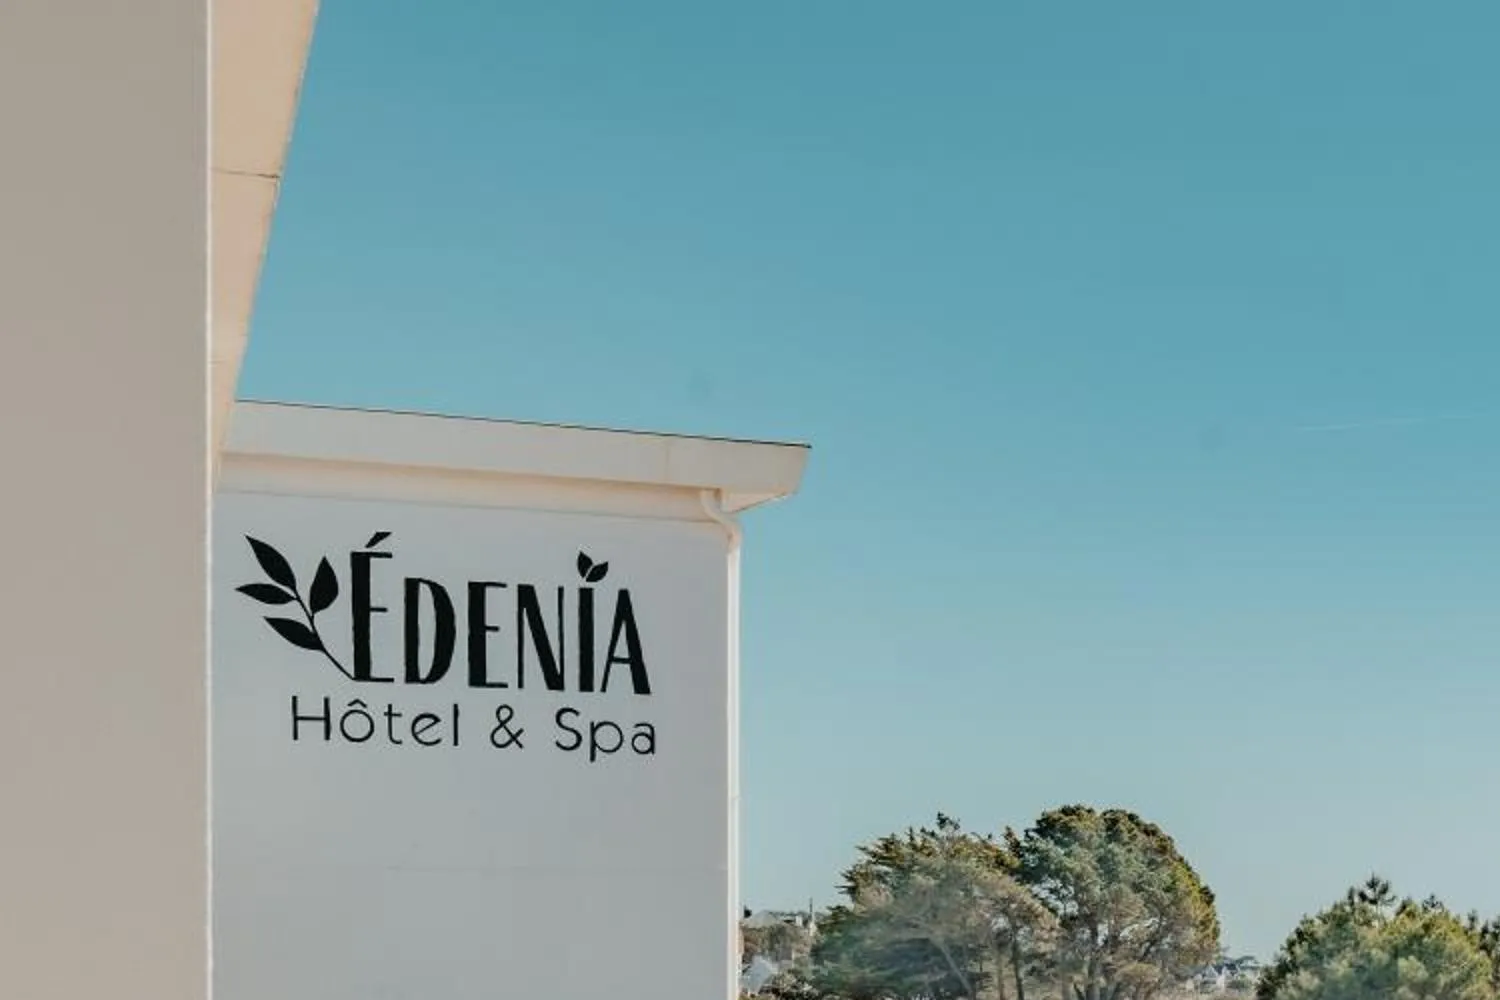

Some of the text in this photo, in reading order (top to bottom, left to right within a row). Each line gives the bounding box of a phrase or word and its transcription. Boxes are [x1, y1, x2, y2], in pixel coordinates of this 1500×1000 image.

[350, 531, 652, 696] ÉDENIA
[291, 695, 656, 763] Hôtel & Spa
